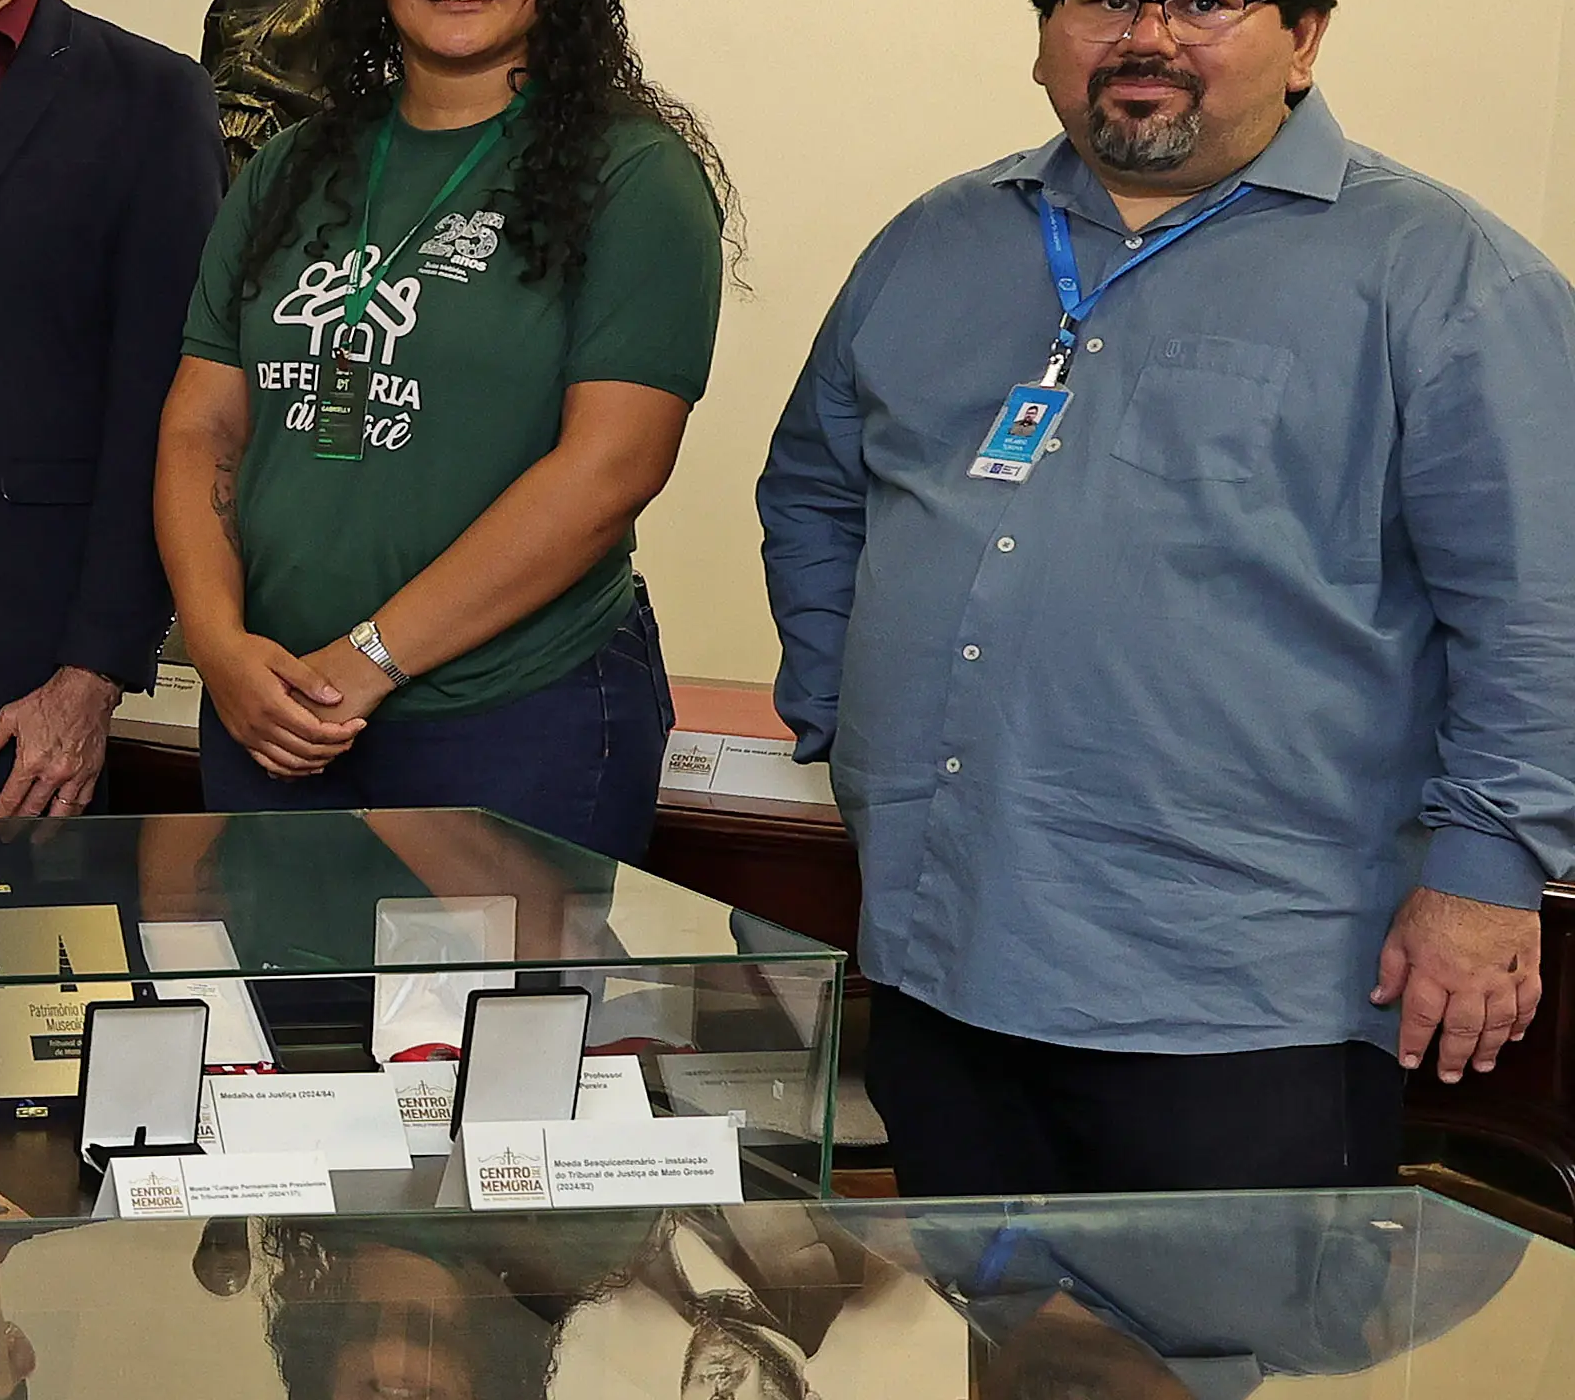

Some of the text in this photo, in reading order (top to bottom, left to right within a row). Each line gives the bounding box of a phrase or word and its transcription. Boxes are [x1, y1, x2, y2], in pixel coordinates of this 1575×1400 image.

[418, 210, 505, 259] 25
[451, 254, 488, 272] anos
[257, 362, 421, 410] DEFERIA
[29, 1003, 79, 1018] Patrimônio
[398, 1098, 447, 1108] CENTRO
[400, 1108, 451, 1119] MEMÓRI
[553, 1159, 582, 1167] Moeda
[583, 1158, 656, 1167] Sesquicentenário
[479, 1167, 530, 1179] CENTRO
[568, 1170, 602, 1178] Tribunal
[616, 1170, 646, 1178] Justiça
[683, 1167, 714, 1175] Grosso
[131, 1186, 172, 1196] CENTRO
